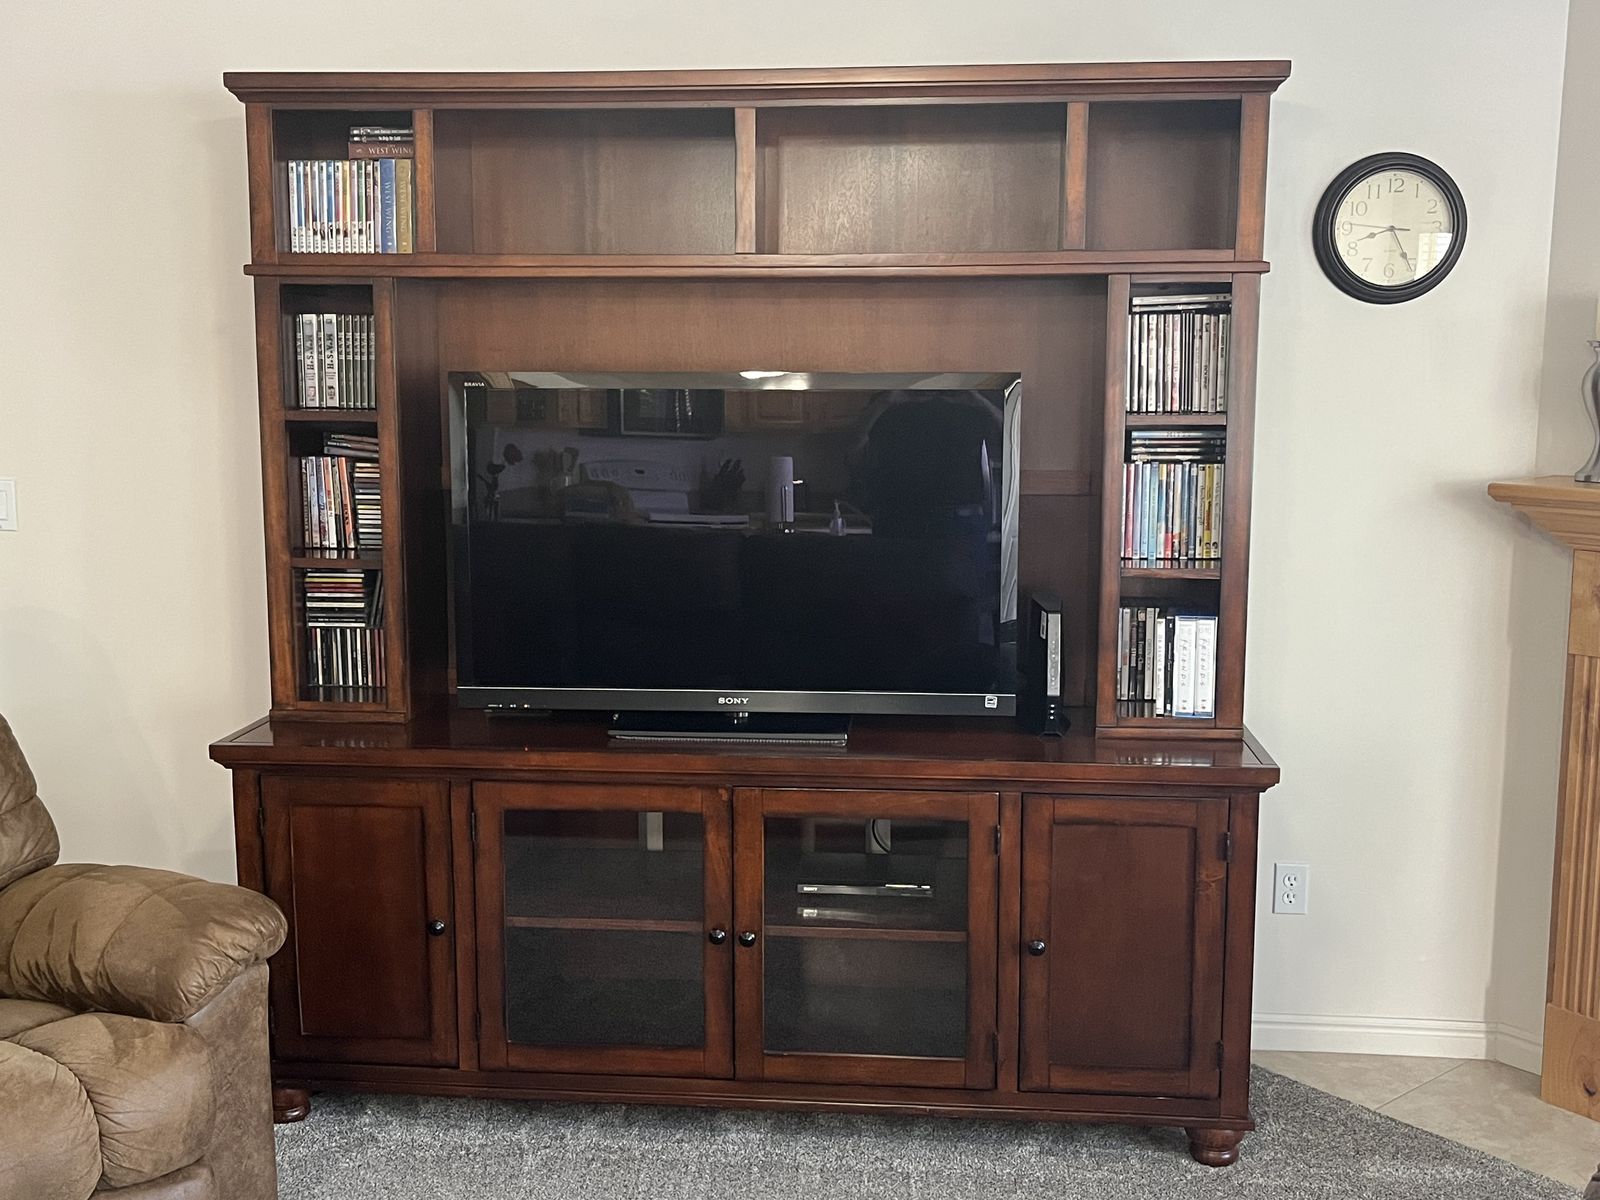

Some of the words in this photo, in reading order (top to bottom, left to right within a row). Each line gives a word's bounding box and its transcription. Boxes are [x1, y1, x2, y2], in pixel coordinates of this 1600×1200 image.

[383, 181, 392, 204] WEST
[1367, 183, 1381, 199] 11
[1388, 177, 1406, 193] 12
[1350, 201, 1368, 216] 10
[1426, 199, 1438, 214] 2
[1341, 221, 1353, 236] 9
[1346, 241, 1358, 257] 8
[1362, 257, 1373, 272] 7
[1383, 263, 1395, 279] 6
